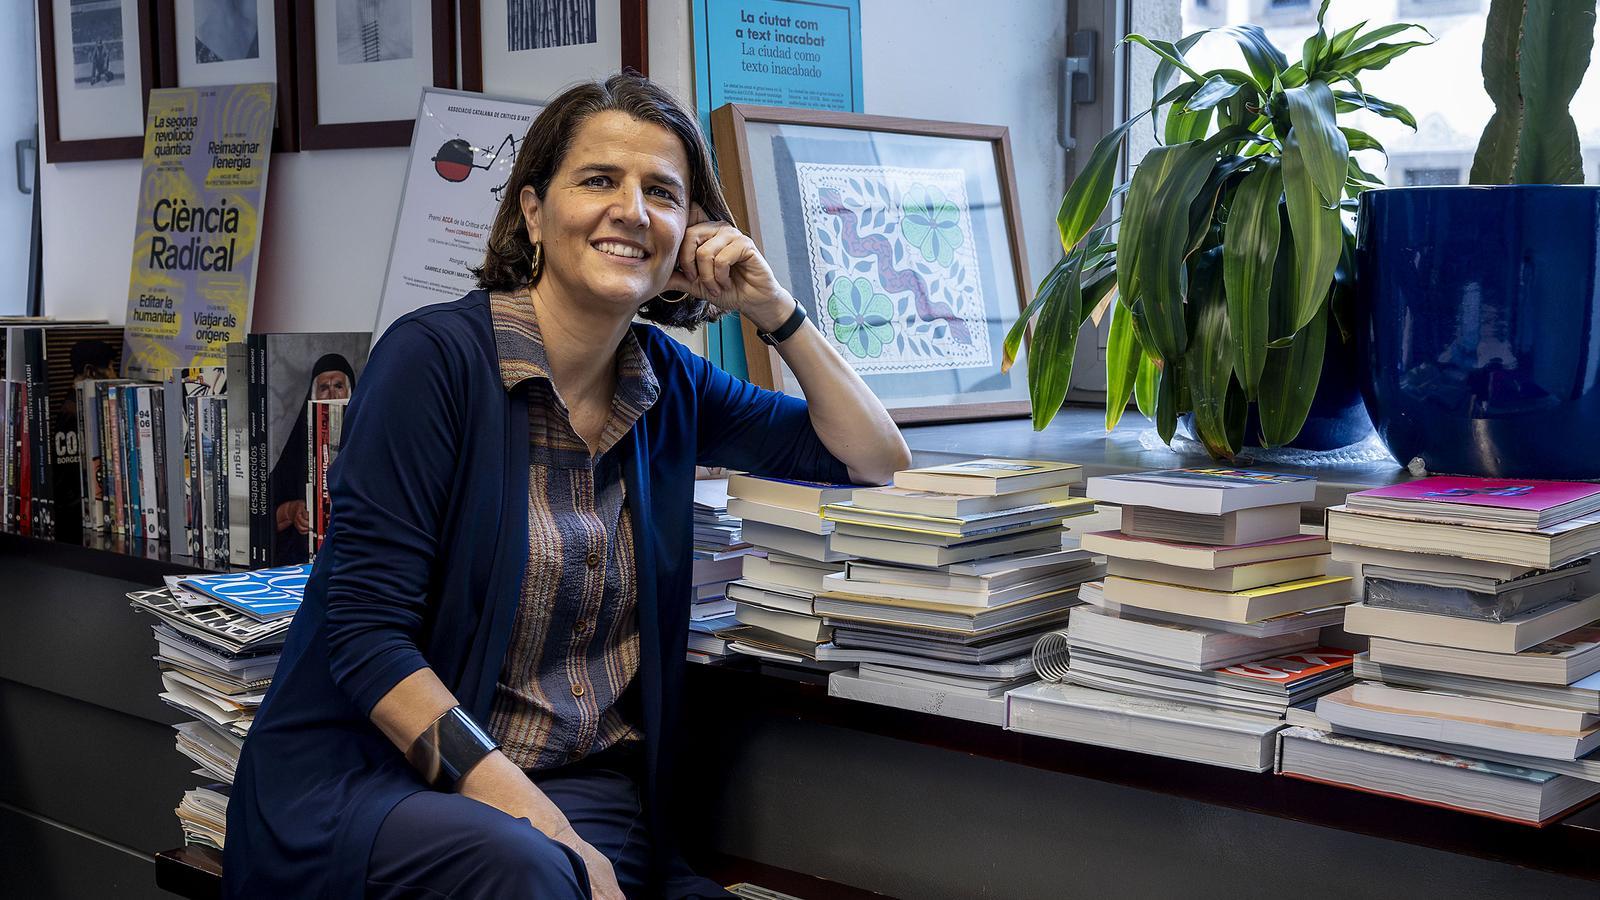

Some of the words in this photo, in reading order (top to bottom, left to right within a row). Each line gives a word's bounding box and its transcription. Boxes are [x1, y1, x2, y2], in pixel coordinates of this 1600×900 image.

[741, 10, 754, 24] La
[759, 12, 791, 28] ciutat
[795, 19, 818, 31] com
[736, 28, 743, 38] a
[748, 29, 771, 41] text
[775, 30, 825, 47] inacabat
[742, 43, 755, 56] La
[758, 46, 791, 60] ciudad
[794, 51, 821, 63] como
[742, 60, 769, 74] texto
[772, 62, 822, 79] inacabado
[154, 116, 165, 128] La
[166, 117, 198, 131] segona
[155, 128, 194, 141] revolució
[154, 143, 191, 157] quàntica
[208, 141, 259, 157] Reimaginar
[212, 156, 251, 172] l'energia
[153, 199, 239, 234] Ciència
[428, 213, 441, 222] Premi
[149, 236, 236, 272] Radical
[140, 294, 164, 309] Editar
[165, 296, 173, 310] la
[133, 308, 176, 324] humanitat
[193, 311, 221, 330] Viatjar
[222, 314, 236, 328] als
[196, 329, 230, 344] origens
[139, 410, 150, 418] 94
[140, 420, 150, 428] 06
[258, 443, 266, 468] olvido
[191, 467, 198, 478] EL
[249, 445, 259, 515] desaparecidos
[259, 480, 267, 516] víctimas
